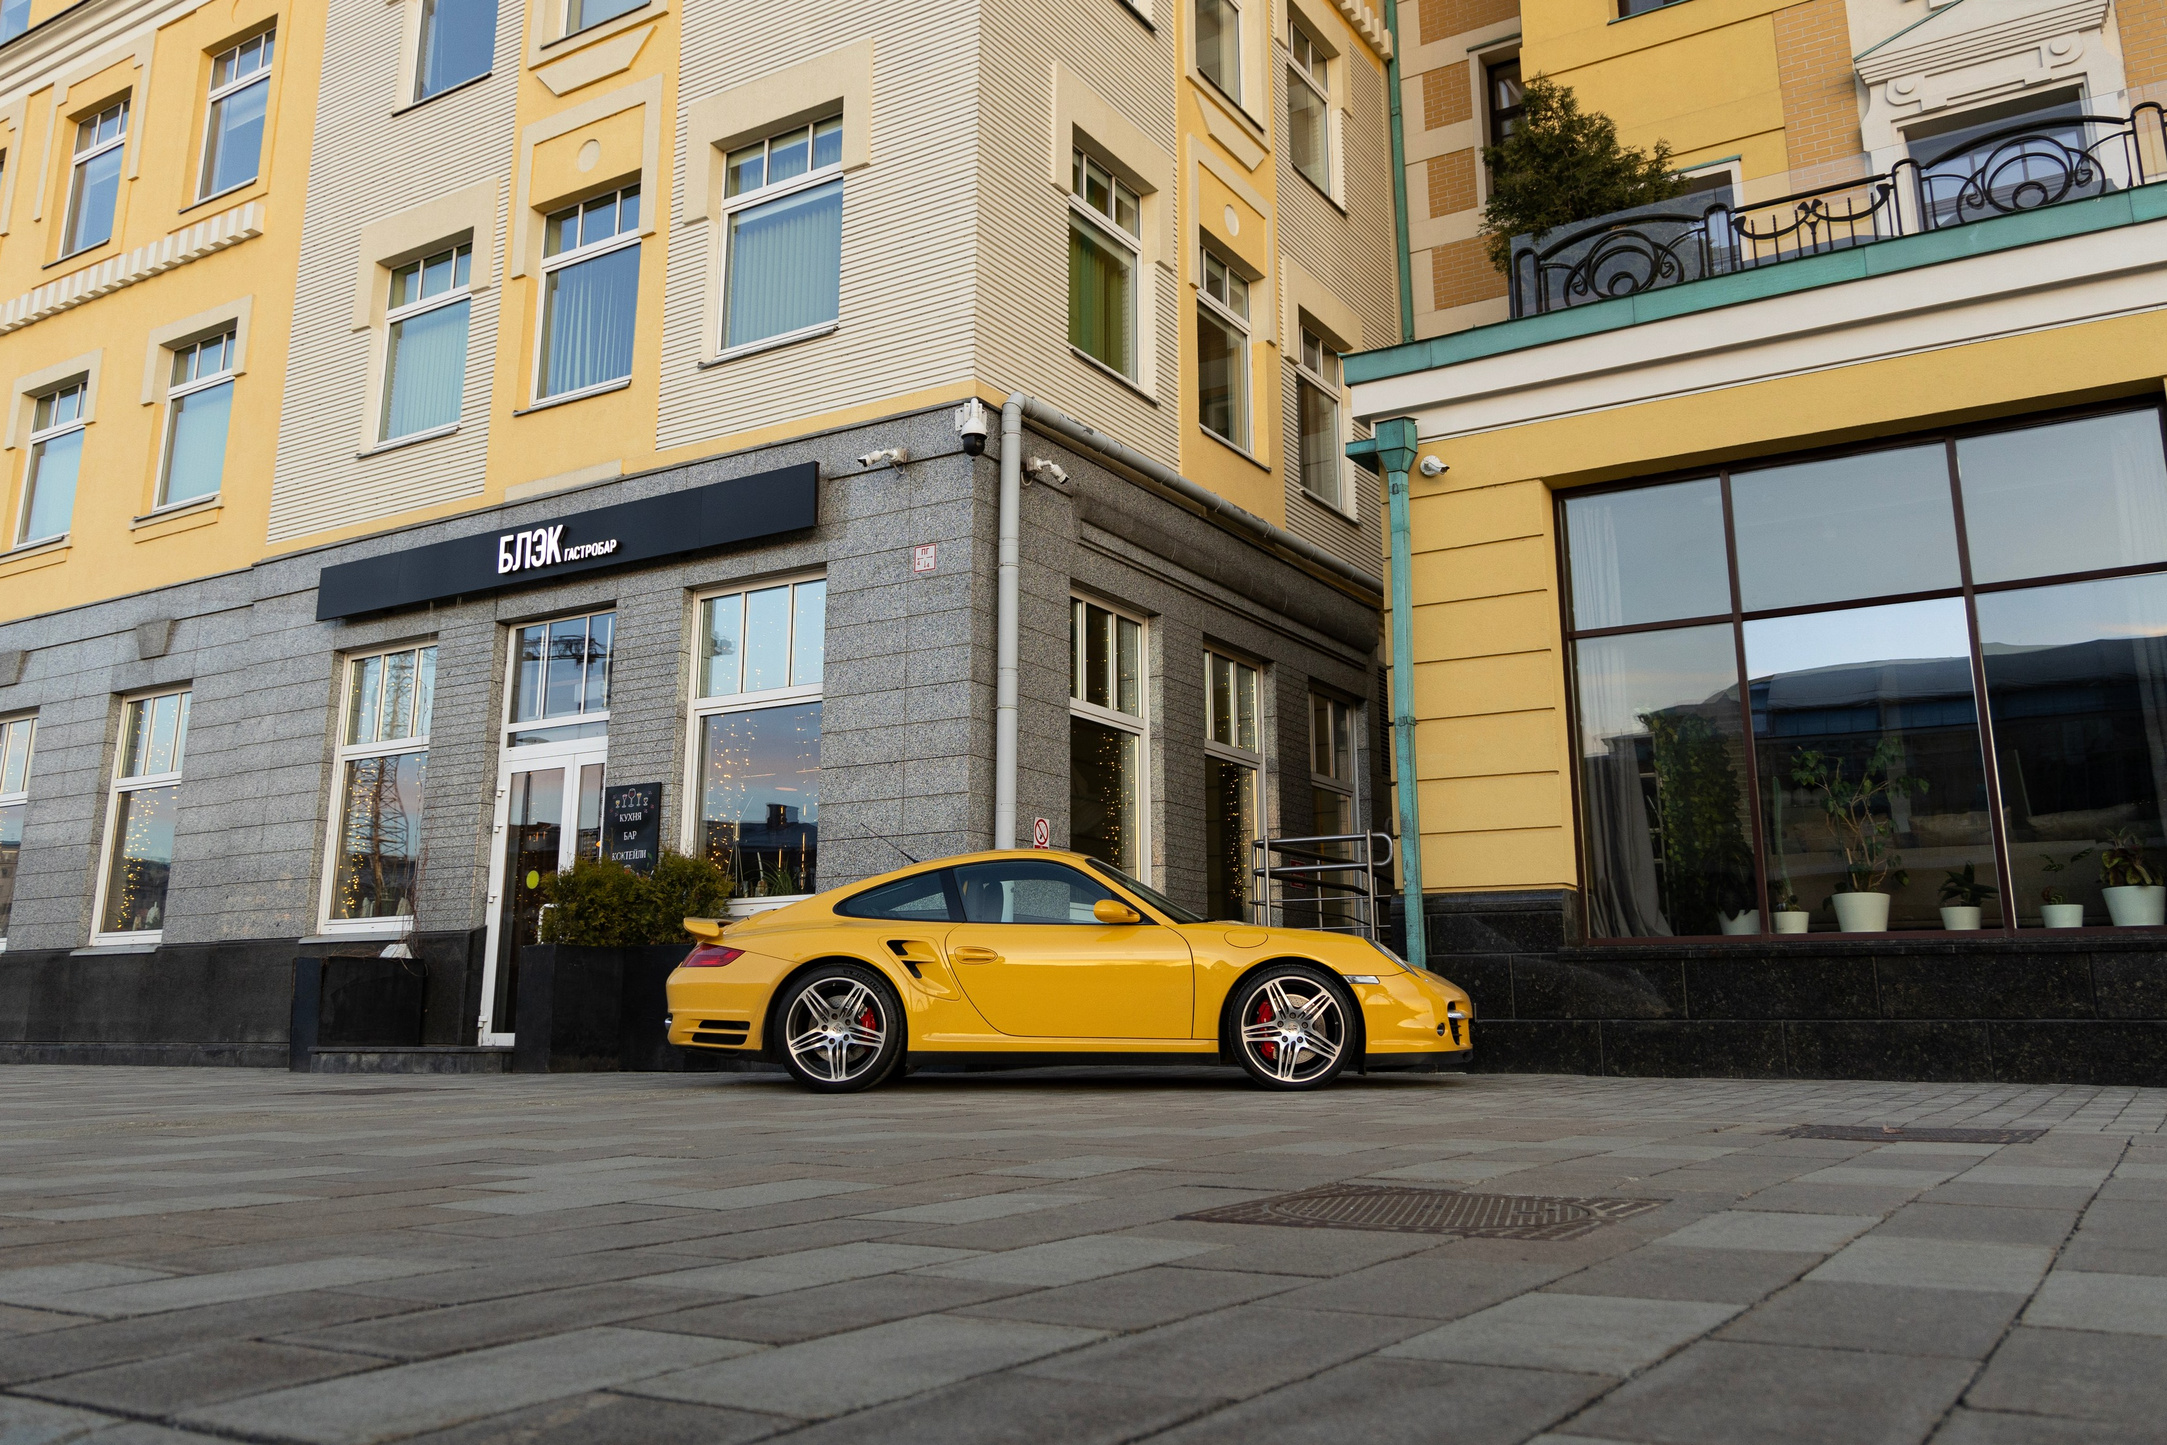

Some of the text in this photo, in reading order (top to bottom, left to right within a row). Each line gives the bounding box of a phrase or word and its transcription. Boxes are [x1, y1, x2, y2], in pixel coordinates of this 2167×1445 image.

[498, 524, 617, 574] БЛЭК ГАСТРОБАР
[619, 812, 642, 822] КУХНЯ
[623, 830, 637, 841] БАР
[611, 849, 647, 861] КОКТЕЙЛИ
